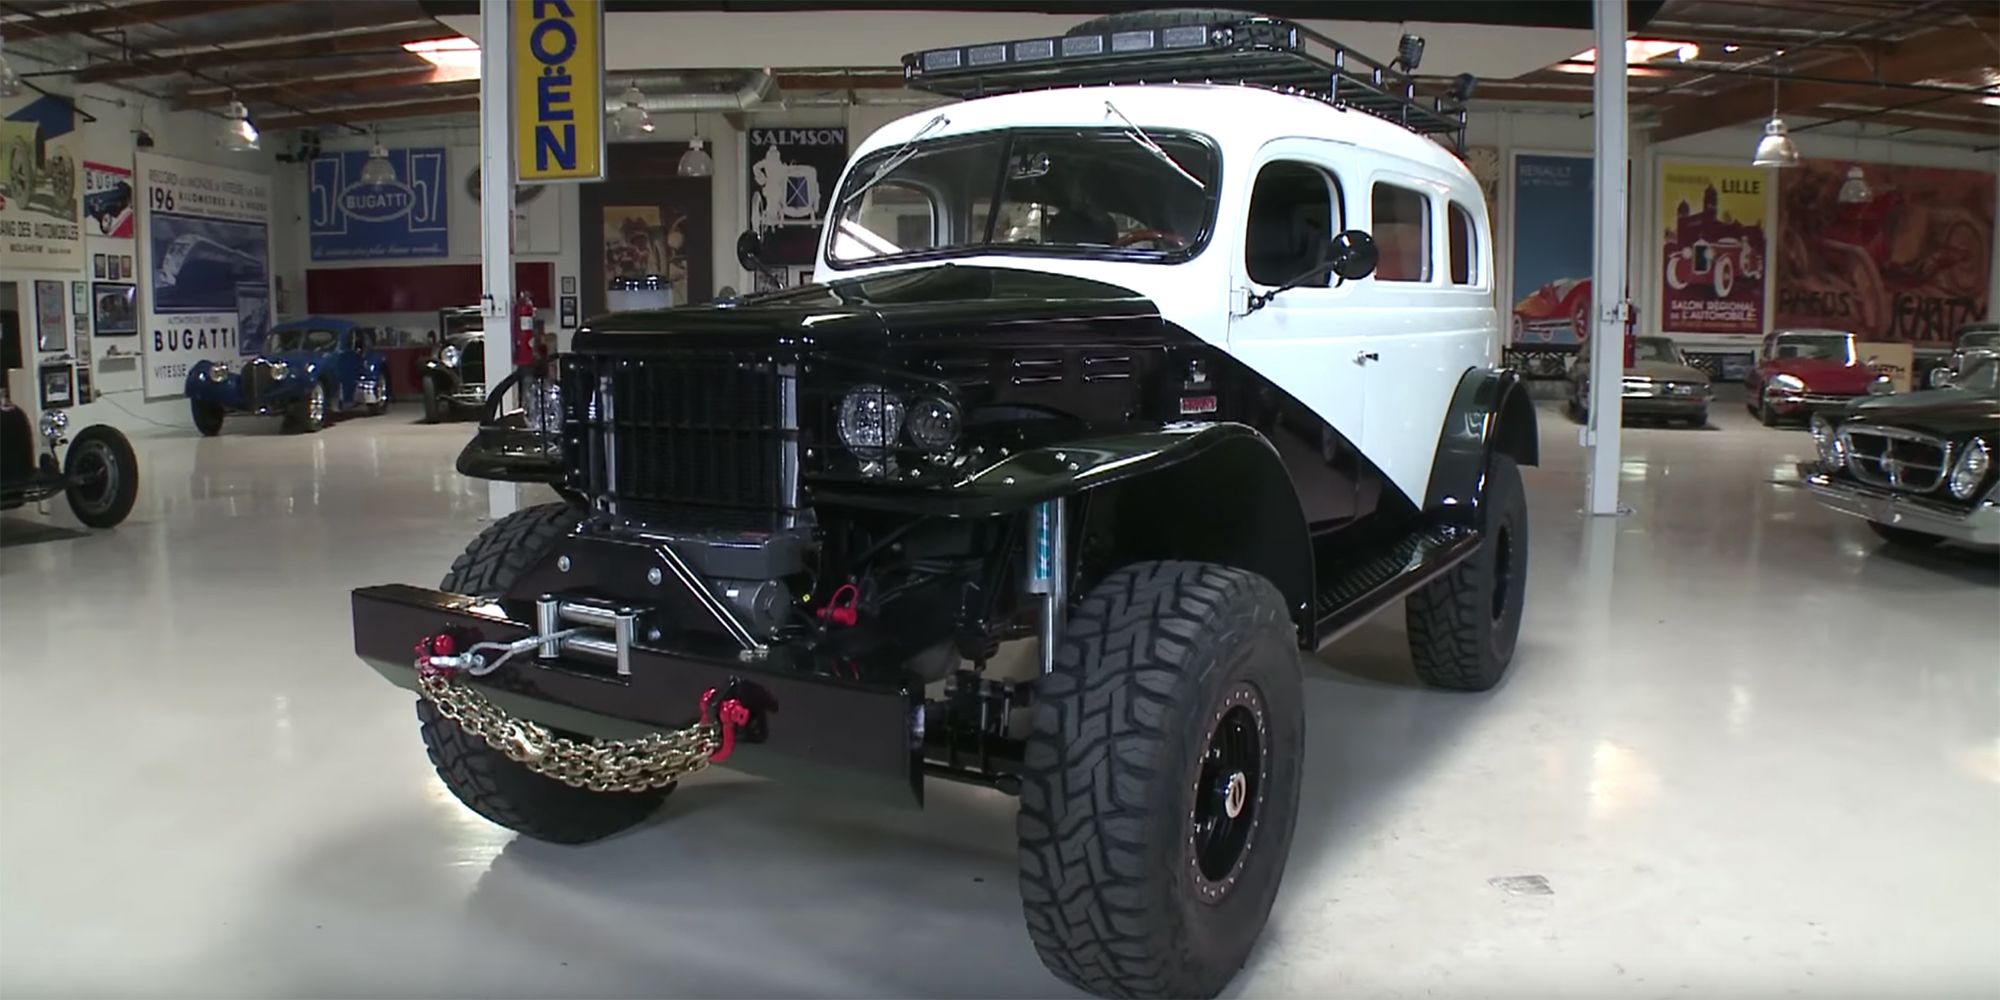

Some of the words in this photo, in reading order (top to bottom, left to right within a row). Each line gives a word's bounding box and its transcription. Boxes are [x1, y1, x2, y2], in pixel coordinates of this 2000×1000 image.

[751, 129, 844, 146] SALMSON
[411, 153, 441, 223] 57
[1721, 179, 1760, 194] LILLE
[149, 186, 175, 211] 196
[346, 193, 407, 209] BUGATTI
[1671, 300, 1704, 310] SALON
[154, 328, 236, 352] BUGATTI
[154, 363, 187, 379] VITESSE
